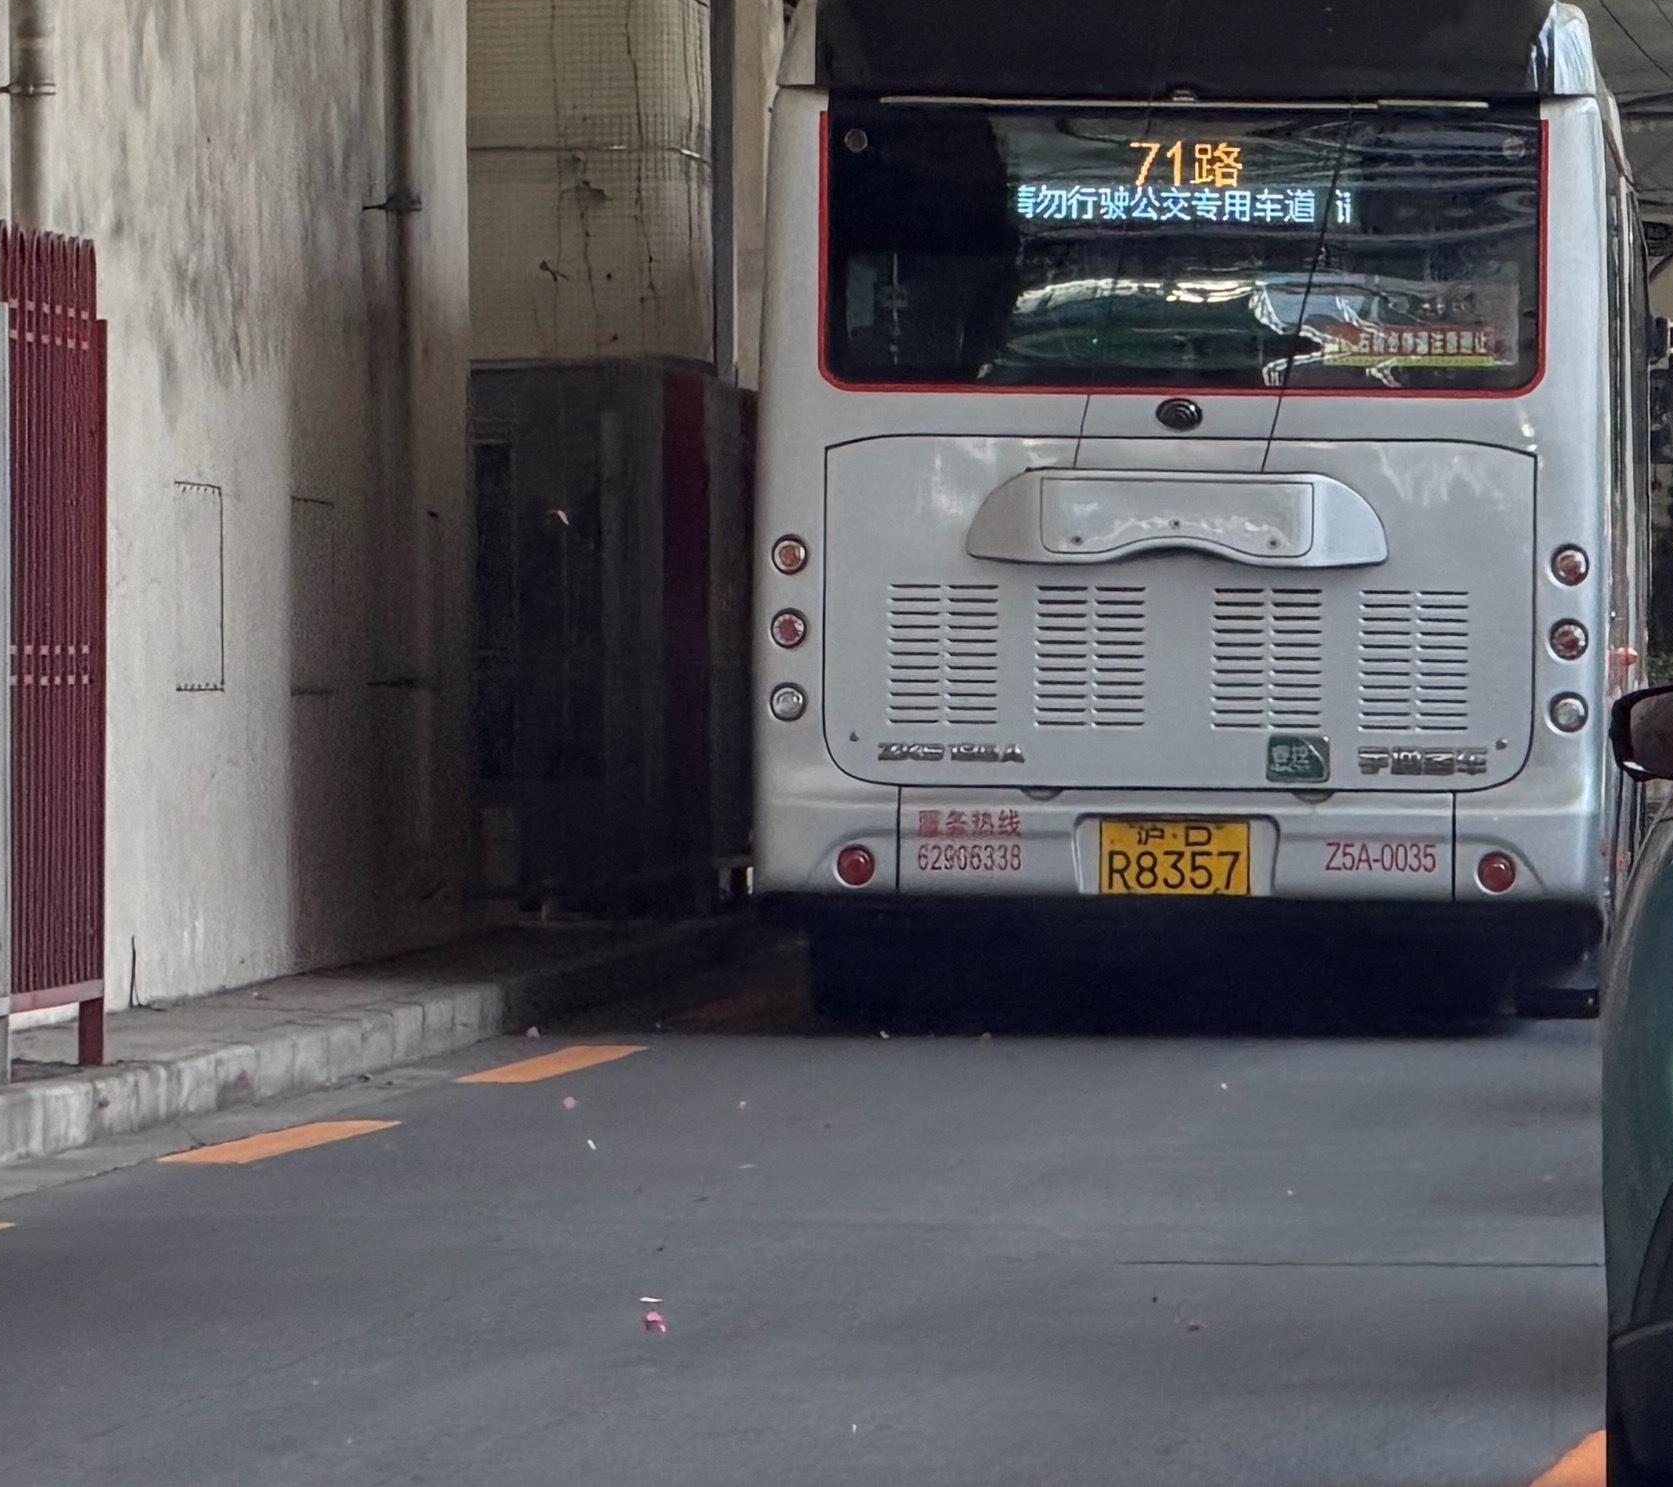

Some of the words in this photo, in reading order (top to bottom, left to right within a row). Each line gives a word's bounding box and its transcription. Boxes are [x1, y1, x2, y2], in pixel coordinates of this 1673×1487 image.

[1130, 141, 1243, 188] 71路
[1108, 850, 1241, 890] R8357
[1325, 841, 1436, 873] Z5A-0035
